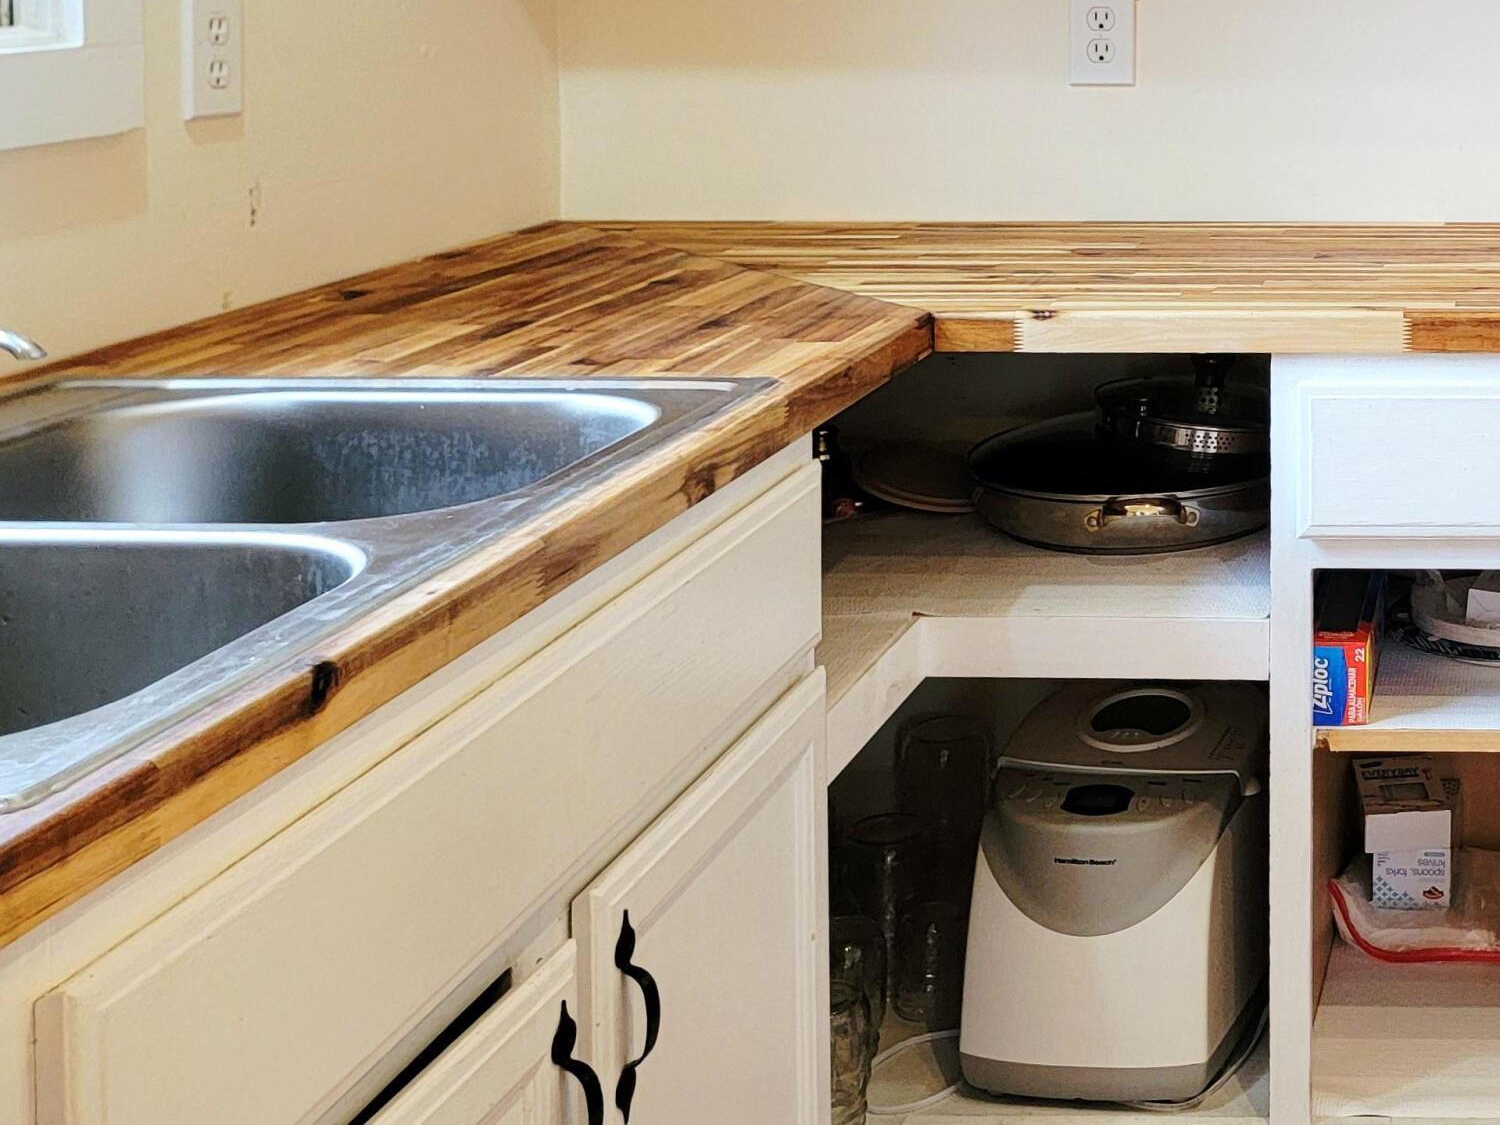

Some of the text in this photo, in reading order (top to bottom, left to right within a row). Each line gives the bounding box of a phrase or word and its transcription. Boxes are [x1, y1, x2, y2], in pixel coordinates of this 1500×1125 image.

[1355, 647, 1365, 663] 22
[1312, 657, 1333, 713] Ziploc
[1054, 857, 1089, 865] Hamilton
[1417, 859, 1446, 868] knives
[1385, 867, 1445, 877] spoons, forks
